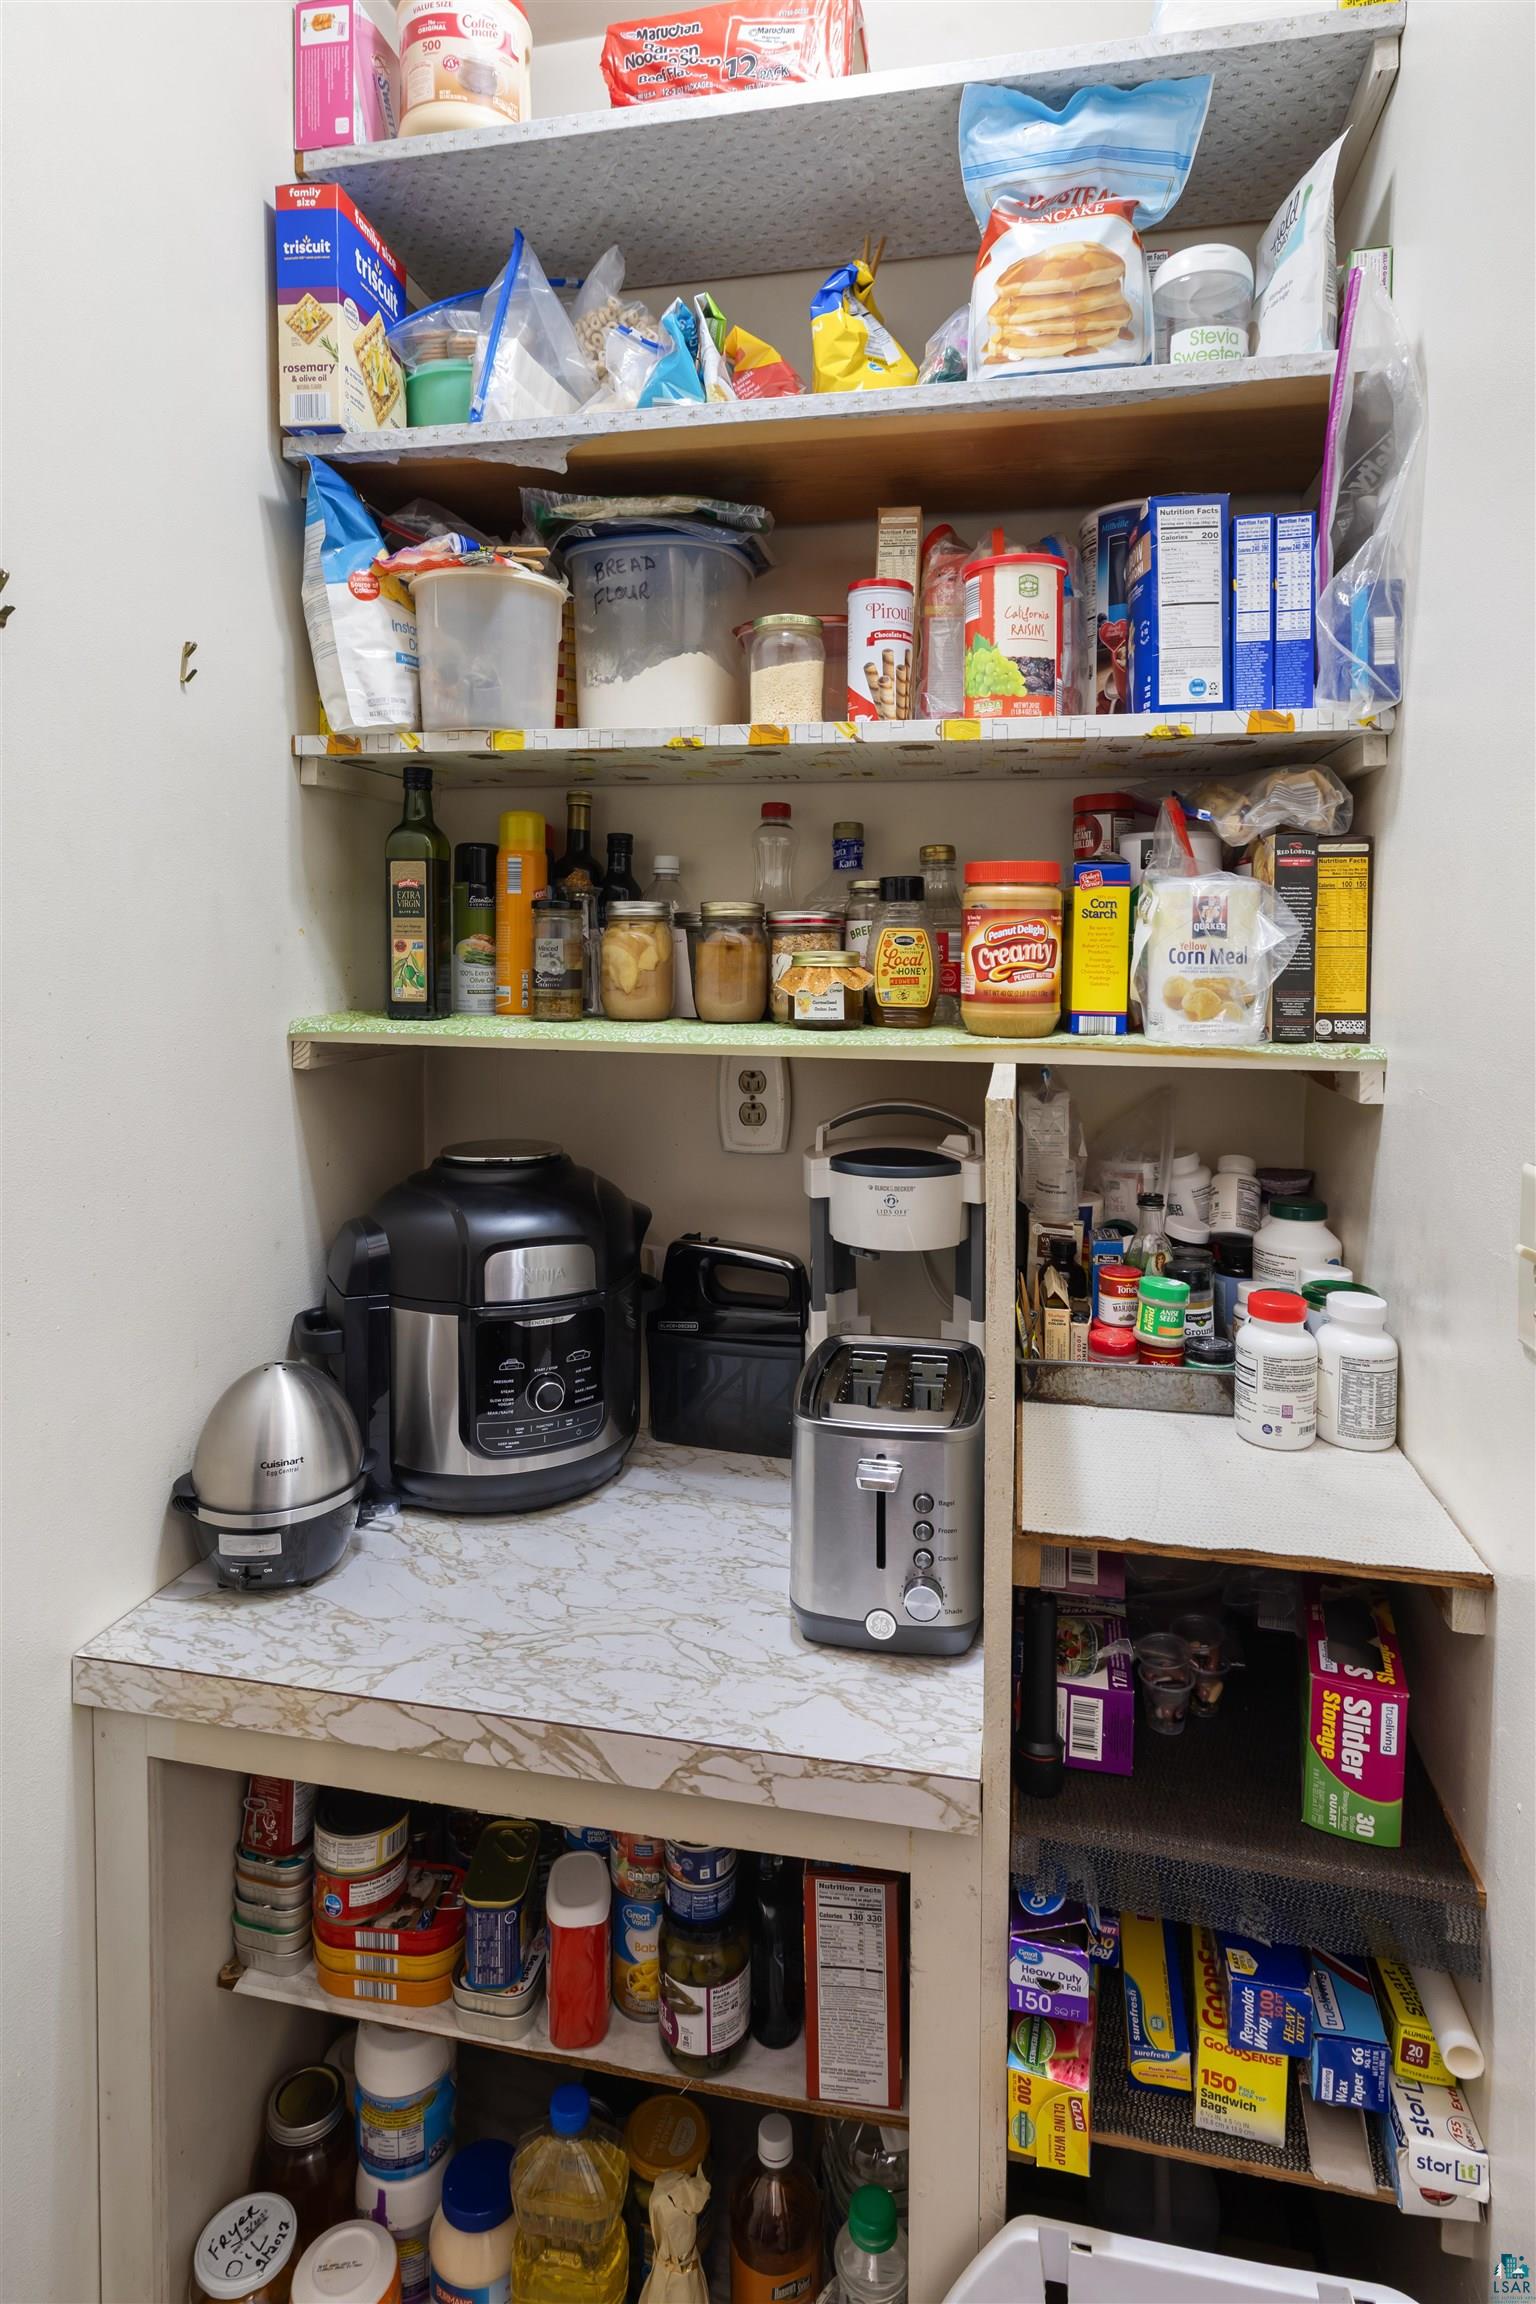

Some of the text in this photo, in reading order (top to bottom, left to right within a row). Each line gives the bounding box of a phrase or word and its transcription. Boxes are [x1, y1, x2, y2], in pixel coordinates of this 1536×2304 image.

[413, 2, 438, 14] VALUE
[417, 23, 447, 35] ORIGINAL
[462, 14, 498, 31] Coffee
[757, 26, 795, 35] Maruchan
[471, 27, 499, 40] mate
[636, 23, 702, 41] Maruchan
[422, 40, 441, 52] 500
[725, 54, 758, 80] 12
[758, 65, 790, 79] PACK
[638, 72, 666, 85] Beef
[289, 187, 321, 199] family
[296, 198, 316, 207] size
[283, 240, 331, 255] triscuit
[354, 208, 398, 272] family size
[354, 247, 399, 318] triscuit
[1190, 328, 1239, 346] Stevia
[283, 362, 335, 375] rosemary
[291, 374, 327, 382] & olive oil
[1160, 508, 1195, 516] Nutrition
[594, 556, 656, 585] BREAD
[592, 581, 650, 616] FLOUR
[1004, 604, 1049, 622] California
[1011, 623, 1045, 638] RAISINS
[1290, 848, 1316, 856] LOBSTER
[839, 859, 858, 869] Karo
[397, 891, 421, 900] EXTRA
[397, 899, 421, 908] VIRGIN
[1090, 898, 1117, 908] Corn
[1082, 909, 1117, 919] Starch
[988, 923, 1046, 942] Peanut Delight
[1193, 923, 1226, 932] QUAKER
[537, 944, 559, 952] Minced
[539, 951, 557, 960] Garlic
[978, 942, 1053, 970] Creamy
[1168, 946, 1248, 965] Corn Meal
[883, 948, 925, 969] Local
[900, 967, 927, 976] HONEY
[1014, 973, 1035, 982] PEANUT
[522, 1267, 567, 1282] NINJA
[1144, 1306, 1155, 1333] Trend
[260, 1456, 304, 1470] Cuisinart
[278, 1467, 299, 1475] Central
[1316, 1689, 1341, 1761] Storage
[1382, 1704, 1396, 1753] trueliving
[1341, 1696, 1373, 1781] Slider
[1328, 1793, 1338, 1829] QUART
[1355, 1812, 1376, 1838] 30
[818, 1882, 882, 1894] Nutrition Facts
[626, 1908, 651, 1922] Great
[631, 1918, 651, 1927] Value
[819, 1911, 883, 1923] Calories 130 330
[1021, 1965, 1055, 1979] Heavy
[1058, 1971, 1081, 1985] Duty
[713, 1981, 738, 1995] Nutrition
[713, 1992, 730, 2000] Facts
[1066, 1983, 1081, 1993] Foil
[1384, 1968, 1418, 2017] Smart
[1016, 1989, 1052, 2013] 150
[1260, 1990, 1275, 2018] 100
[1054, 2007, 1081, 2018] SQ FT
[1129, 1989, 1141, 2041] surefresh
[1240, 1986, 1255, 2046] Reynolds
[1283, 2002, 1296, 2045] HEAVY
[1296, 2012, 1306, 2043] DUTY
[1254, 2017, 1273, 2051] Wrap
[1134, 2050, 1171, 2060] surefresh
[1203, 2036, 1284, 2067] GOODSENSE
[1408, 2044, 1424, 2059] 20
[1201, 2068, 1237, 2094] 150
[1351, 2047, 1367, 2107] Paper 66
[1017, 2075, 1031, 2106] 200
[1336, 2079, 1349, 2103] Wax
[1200, 2098, 1228, 2115] Bags
[1201, 2087, 1257, 2112] Sandwich
[1070, 2100, 1085, 2130] GLAD
[1054, 2103, 1066, 2166] CLING WRAP
[1451, 2120, 1463, 2139] 155
